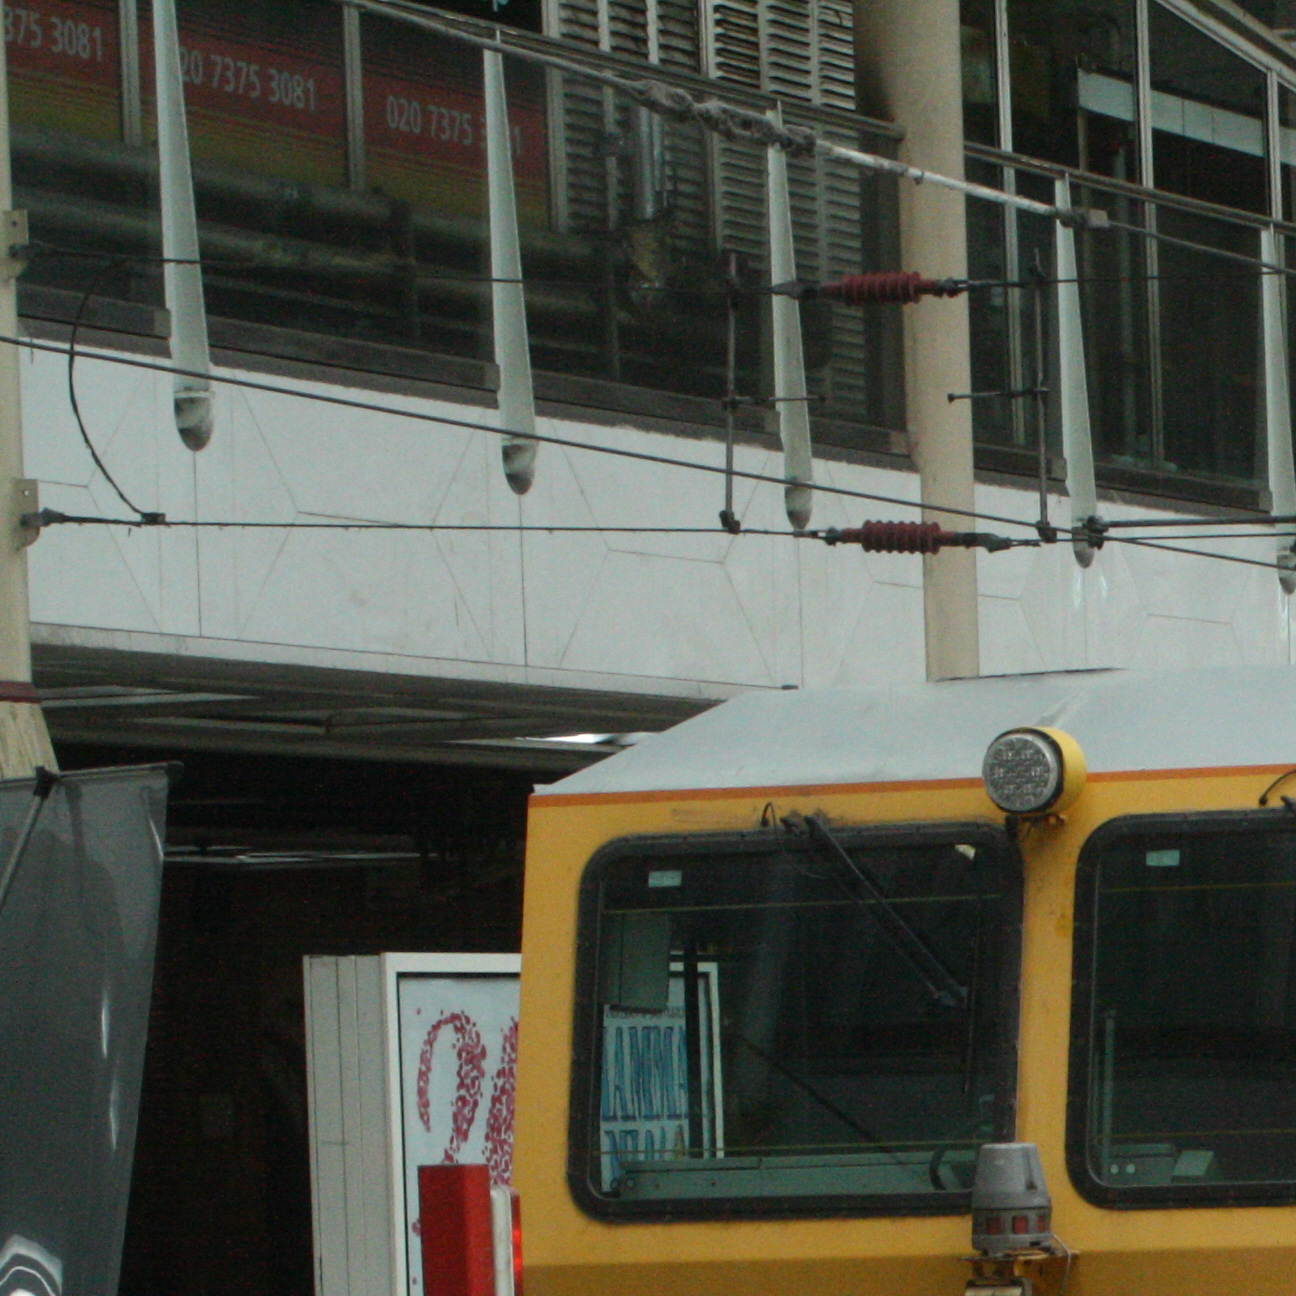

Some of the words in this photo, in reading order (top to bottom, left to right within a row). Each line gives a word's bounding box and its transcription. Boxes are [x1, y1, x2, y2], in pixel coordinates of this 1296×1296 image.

[179, 45, 203, 85] 20
[211, 54, 261, 98] 7375
[268, 67, 317, 114] 3081
[386, 95, 421, 135] 020
[427, 105, 473, 146] 7375
